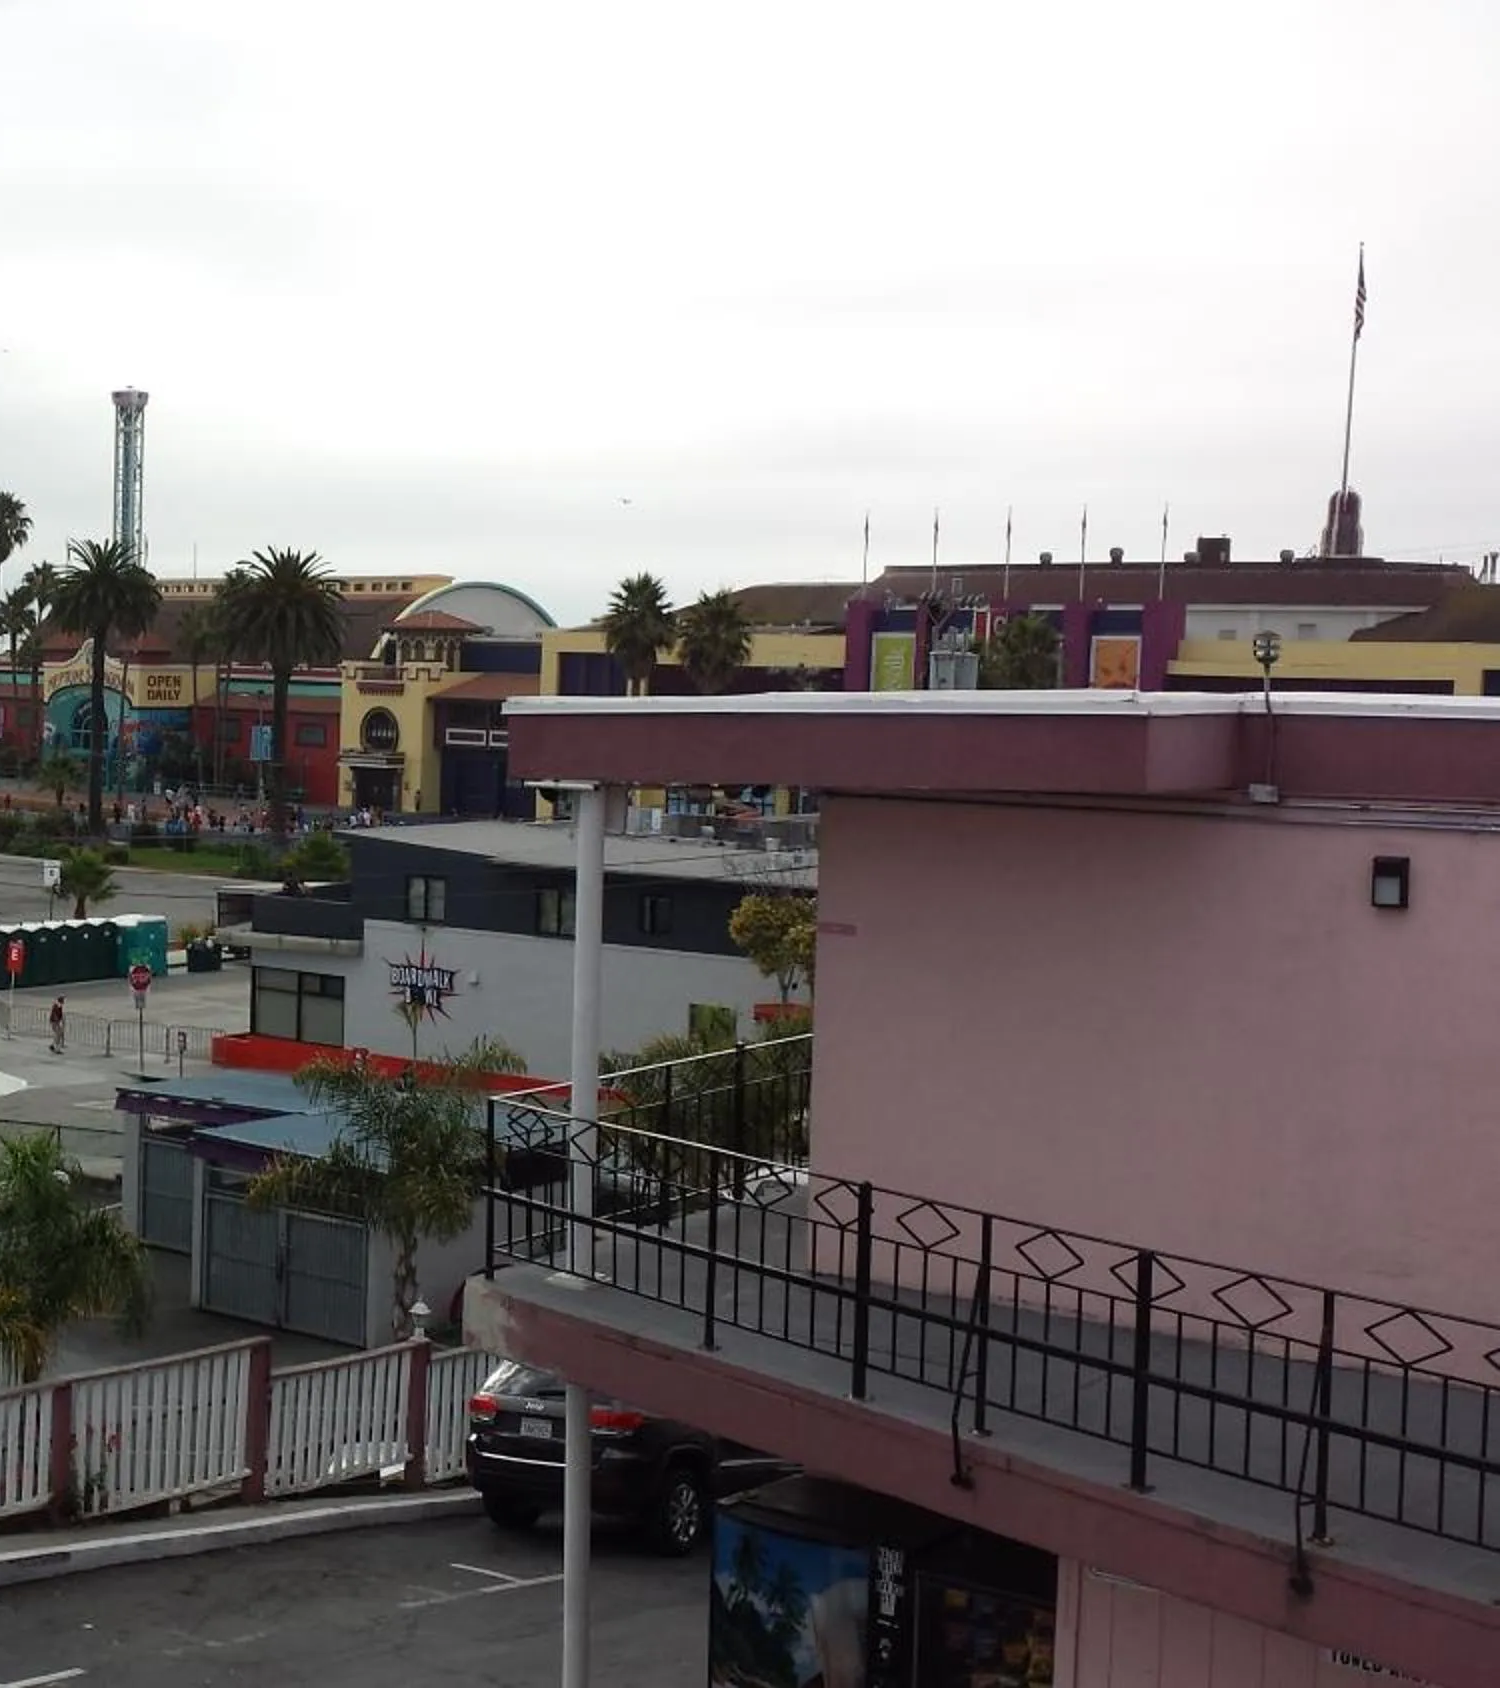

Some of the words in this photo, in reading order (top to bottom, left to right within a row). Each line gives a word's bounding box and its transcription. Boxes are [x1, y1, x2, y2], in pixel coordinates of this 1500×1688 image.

[147, 674, 181, 687] OPEN
[147, 689, 181, 701] DAILY
[390, 966, 450, 988] BOARDWALK
